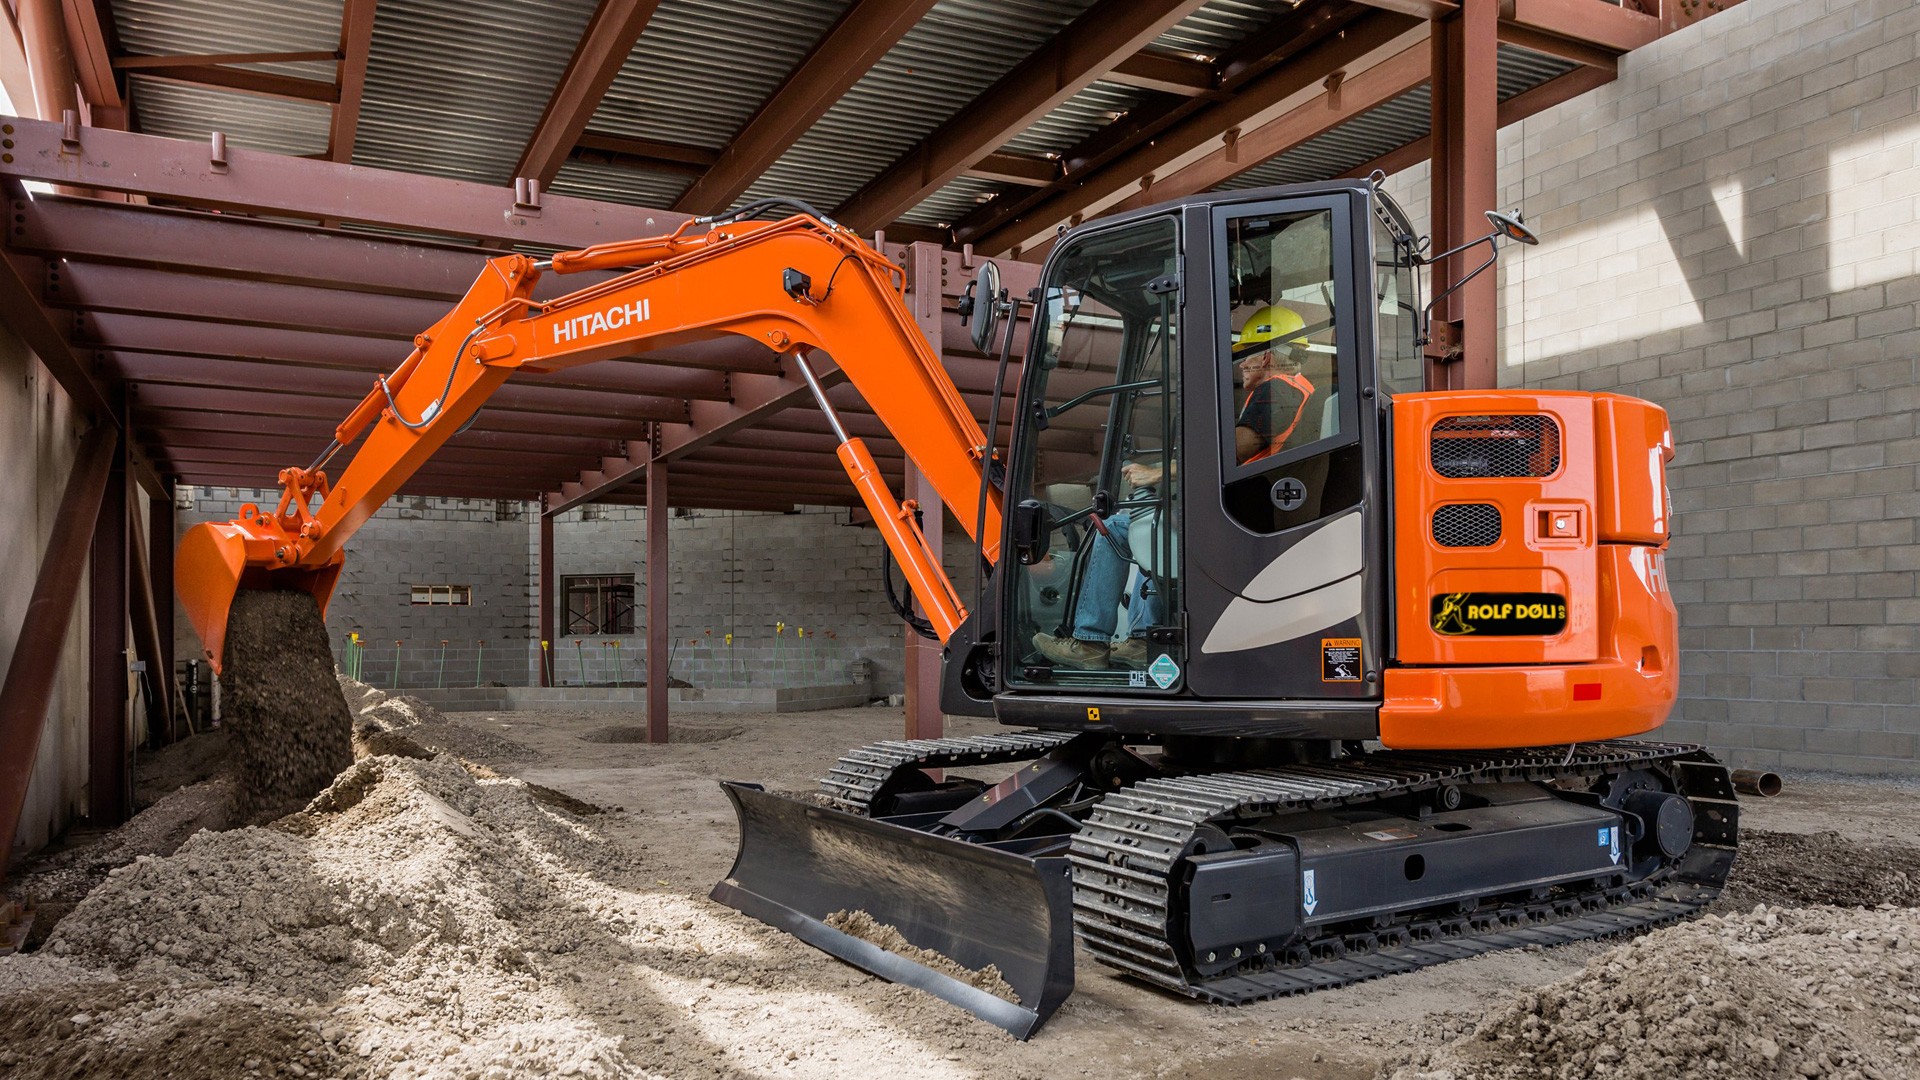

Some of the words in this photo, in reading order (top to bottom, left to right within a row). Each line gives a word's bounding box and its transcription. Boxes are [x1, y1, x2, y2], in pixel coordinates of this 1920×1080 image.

[553, 298, 650, 344] HITACHI
[1468, 603, 1513, 619] ROLF
[1516, 603, 1556, 619] DØLI
